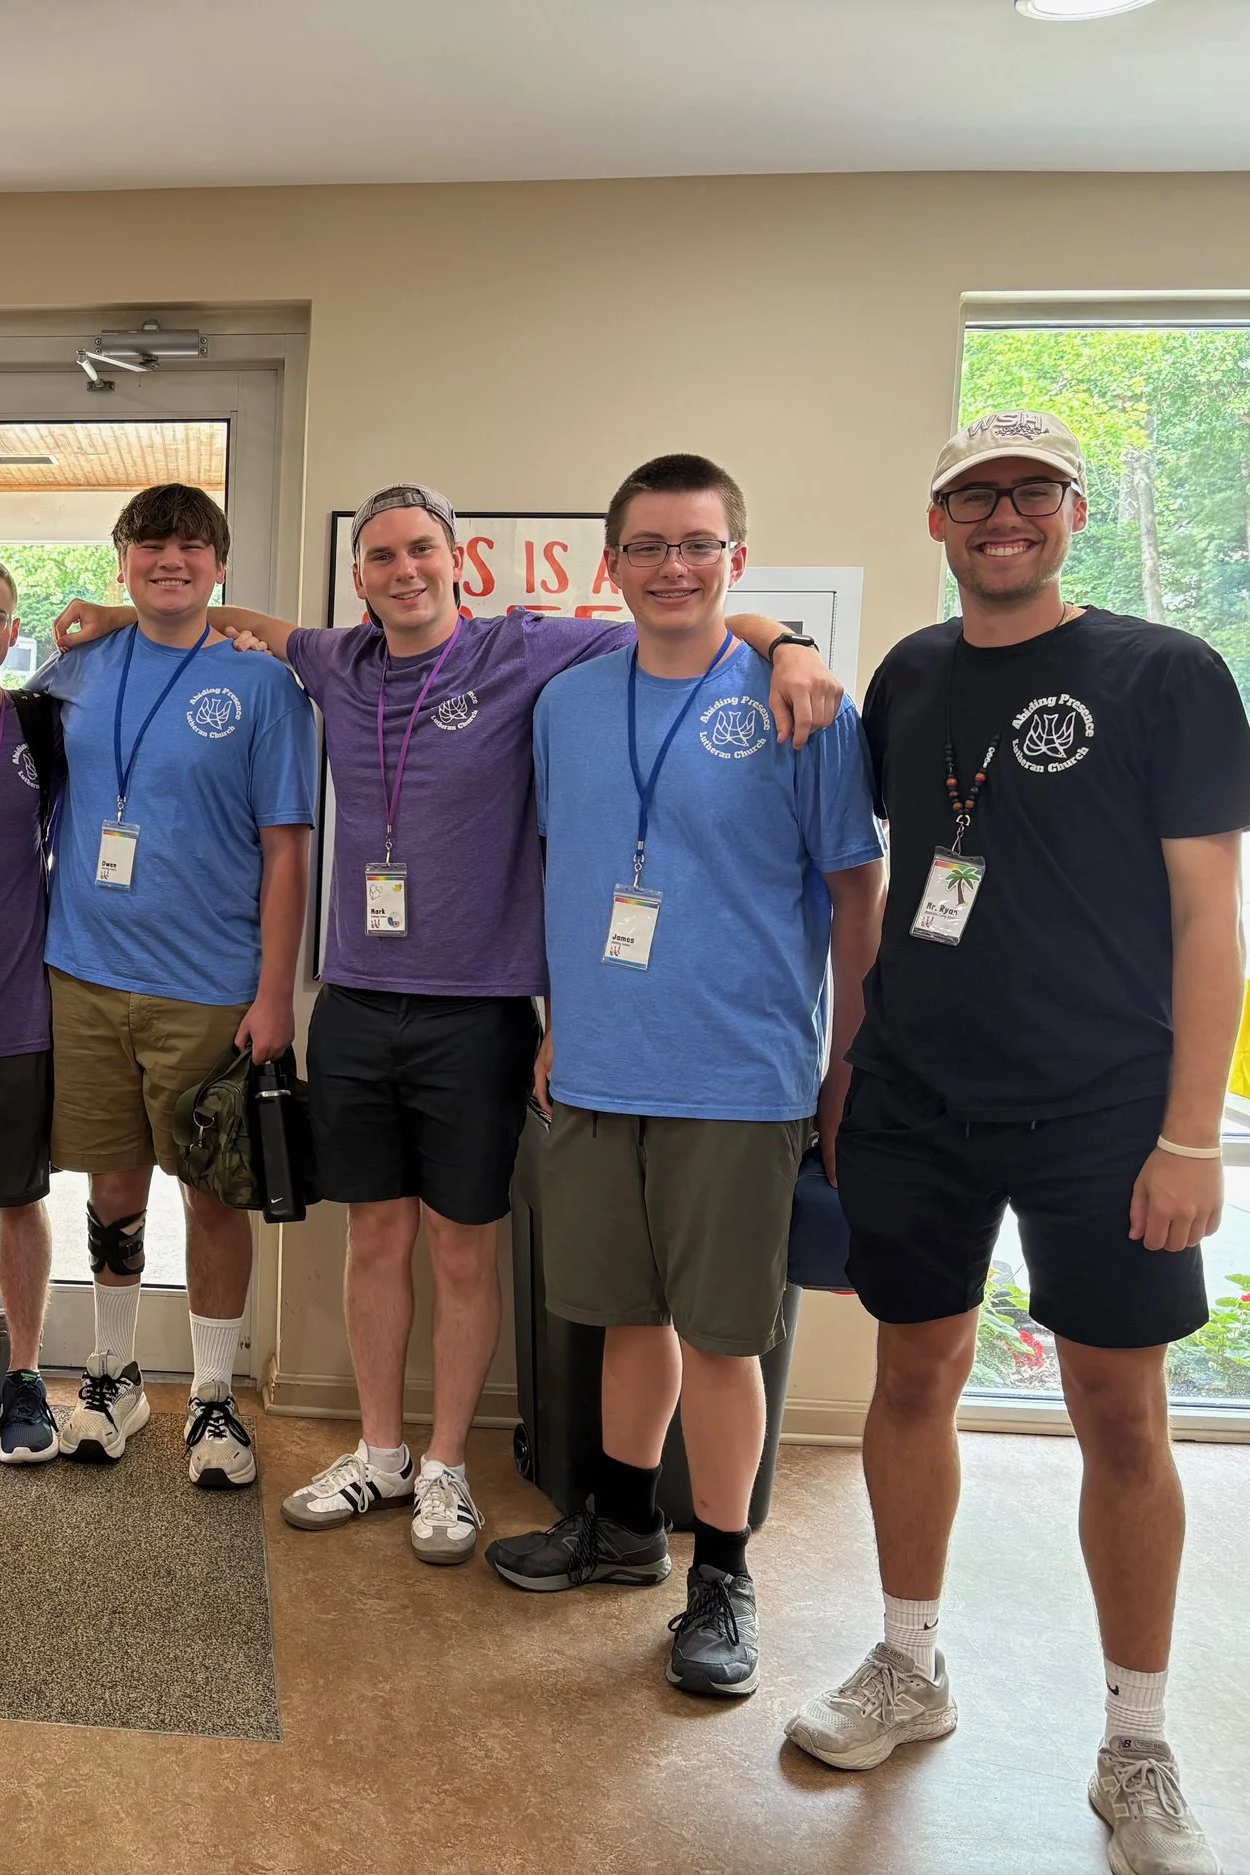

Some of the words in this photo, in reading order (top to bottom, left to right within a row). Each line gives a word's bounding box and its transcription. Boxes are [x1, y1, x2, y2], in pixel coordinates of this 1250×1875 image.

[525, 541, 568, 595] IS
[190, 688, 220, 705] Abiding
[221, 688, 242, 720] Presence
[700, 696, 738, 724] Abiding
[741, 696, 770, 730] Presence
[1012, 697, 1057, 730] Abiding
[1058, 694, 1094, 737] Presence
[186, 711, 207, 738] Lutheran
[209, 726, 235, 738] Church
[700, 731, 731, 758] Lutheran
[734, 738, 766, 759] Church
[1012, 739, 1044, 773] Lutheran
[1048, 747, 1089, 772] Church
[101, 860, 117, 869] Owen
[939, 904, 958, 916] Ryan
[612, 933, 635, 944] James
